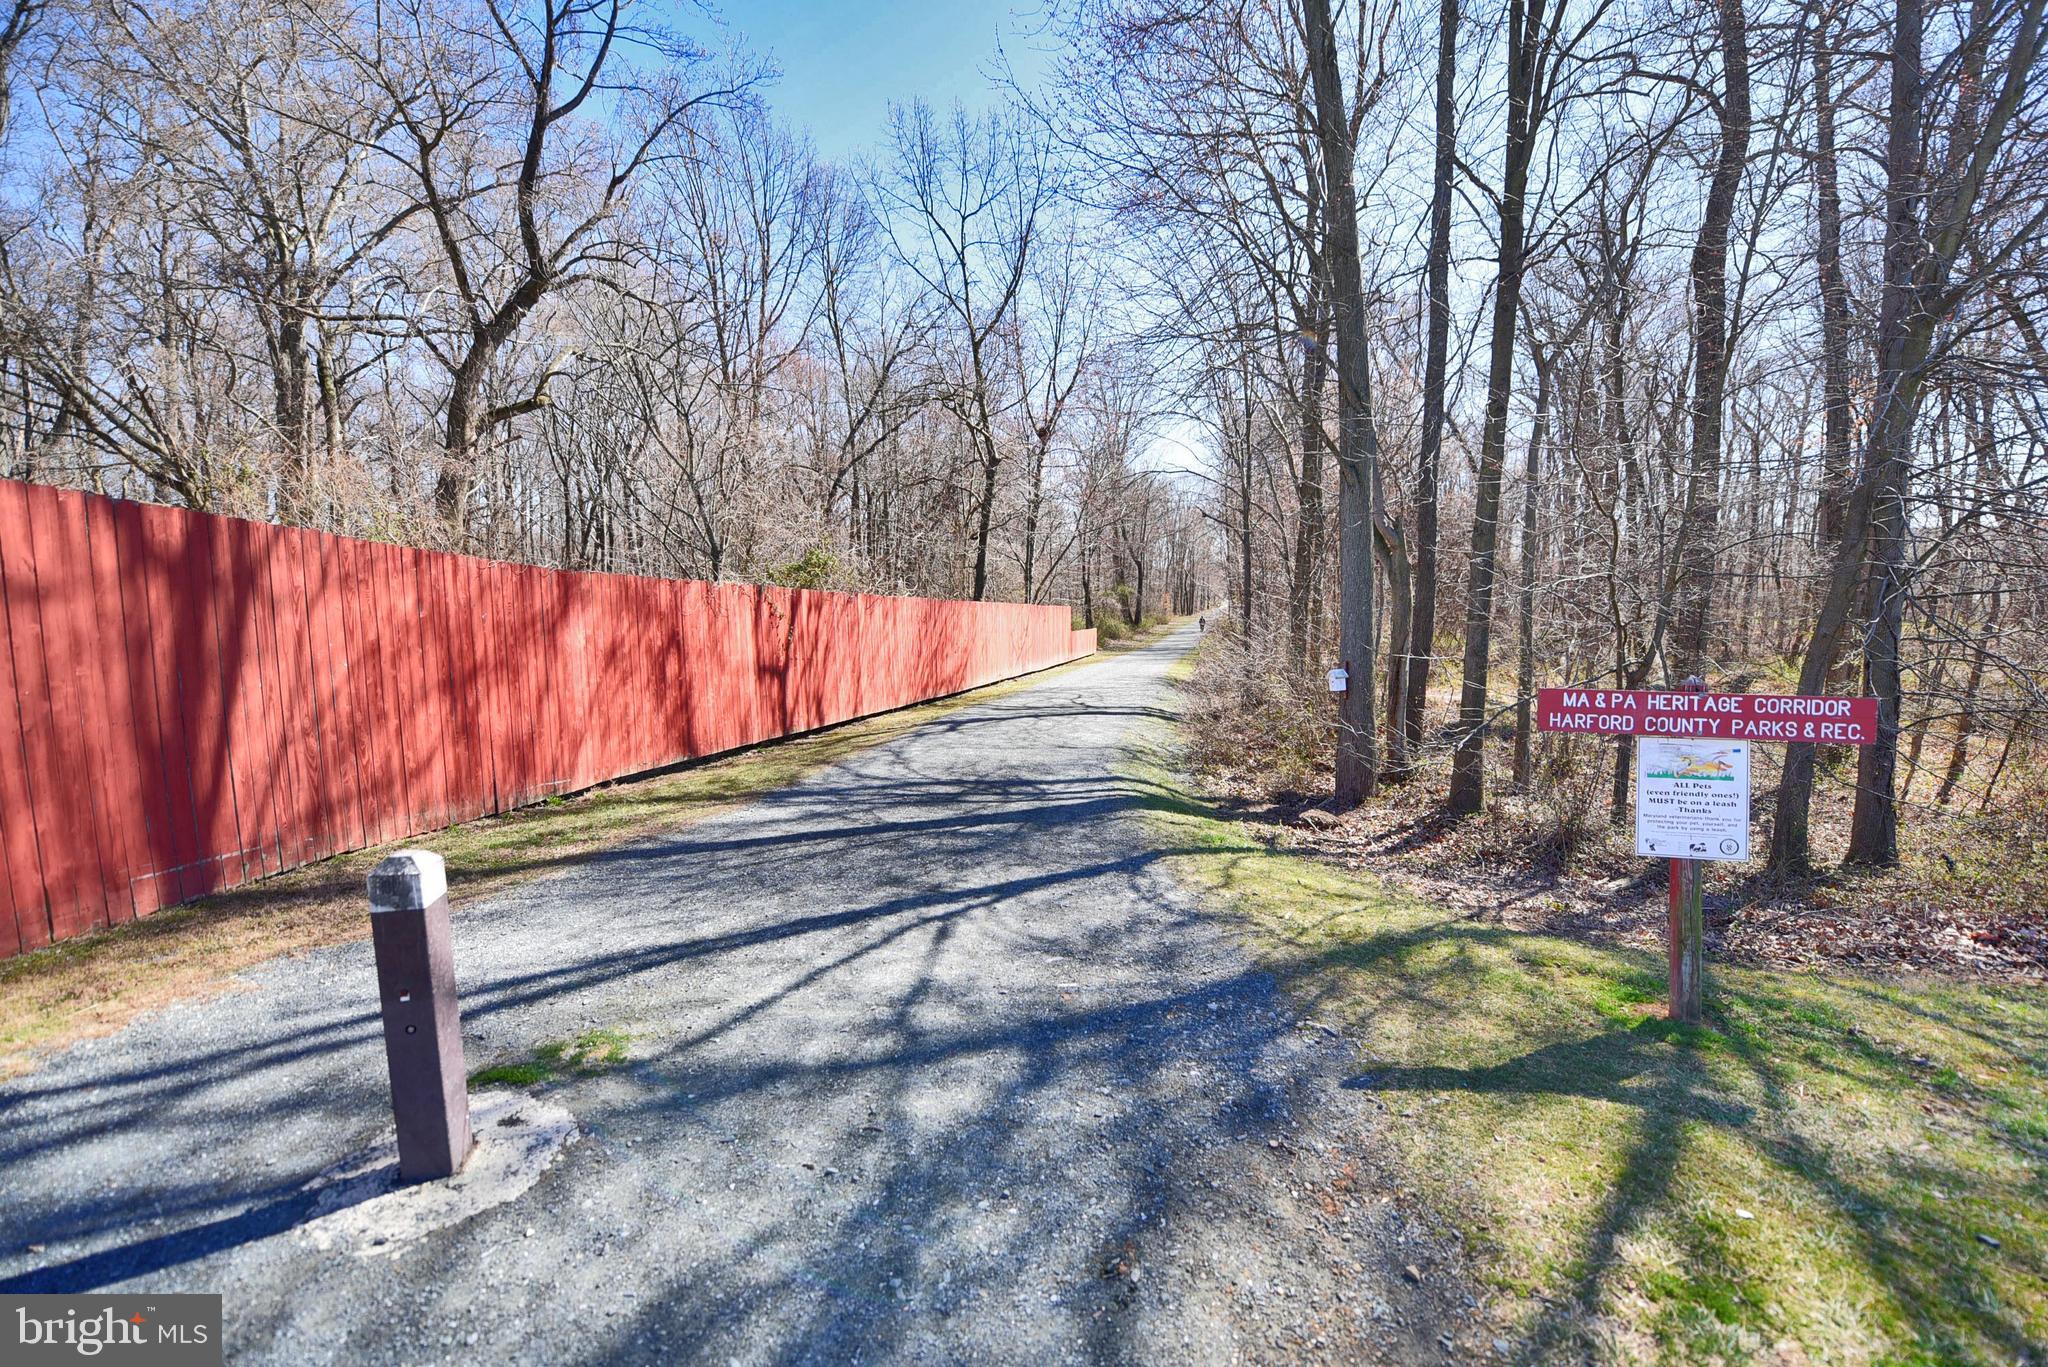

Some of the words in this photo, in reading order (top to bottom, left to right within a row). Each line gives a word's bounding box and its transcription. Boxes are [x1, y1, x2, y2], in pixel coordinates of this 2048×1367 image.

[1563, 692, 1589, 707] MA
[1594, 693, 1607, 708] &
[1611, 693, 1636, 709] PA
[1647, 694, 1743, 713] HERITAGE
[1754, 698, 1851, 716] CORRIDOR
[1549, 712, 1635, 731] HARFORD
[1644, 716, 1720, 735] COUNTY
[1731, 720, 1798, 737] PARKS
[1803, 723, 1815, 738] &
[1821, 722, 1865, 740] REC.
[1673, 790, 1708, 798] friendly
